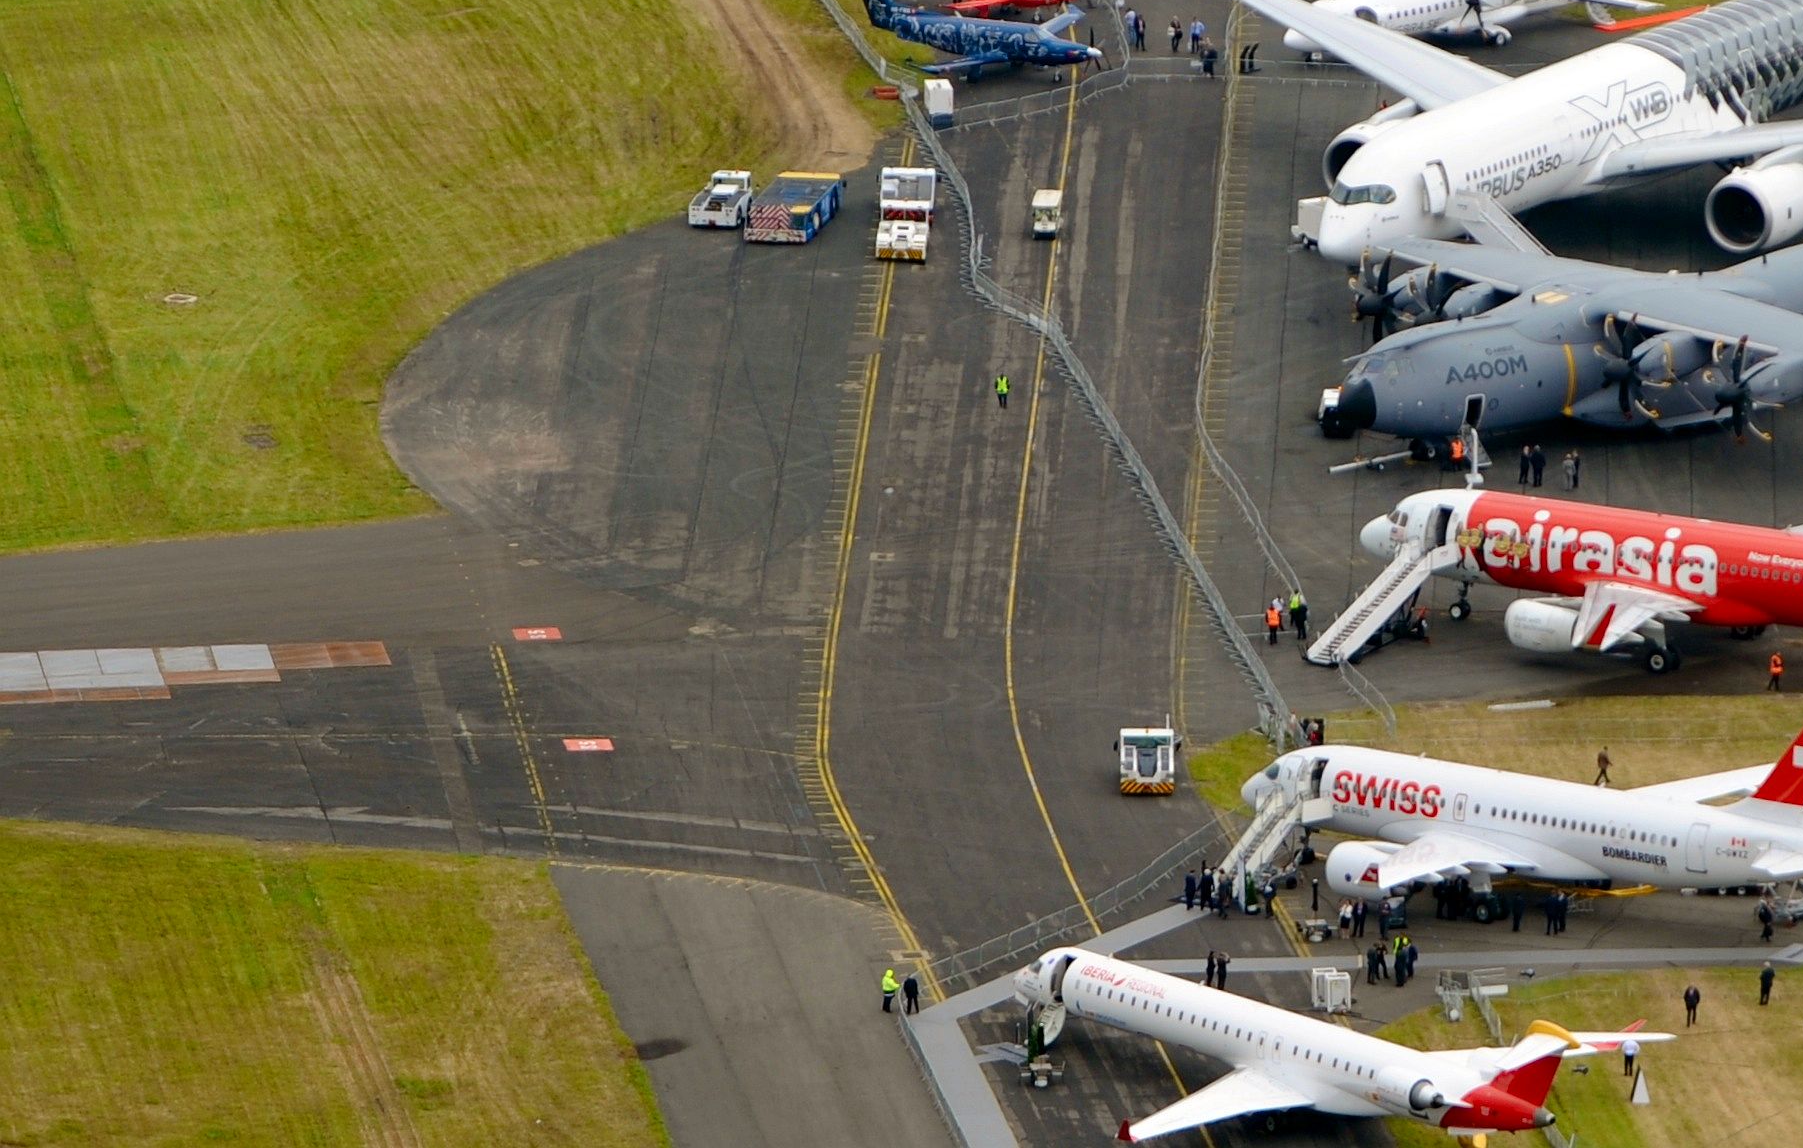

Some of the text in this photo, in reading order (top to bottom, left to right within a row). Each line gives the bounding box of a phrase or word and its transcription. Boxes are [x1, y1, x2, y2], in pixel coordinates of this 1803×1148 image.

[1527, 153, 1562, 182] A350
[1446, 355, 1528, 385] A400M
[1483, 510, 1719, 598] airasia
[1748, 551, 1770, 563] Now
[1332, 770, 1441, 818] SWISS
[1341, 806, 1370, 818] SERIES
[1602, 846, 1668, 867] BOMBARDIER
[1081, 965, 1167, 999] IBERIA REGIONAL
